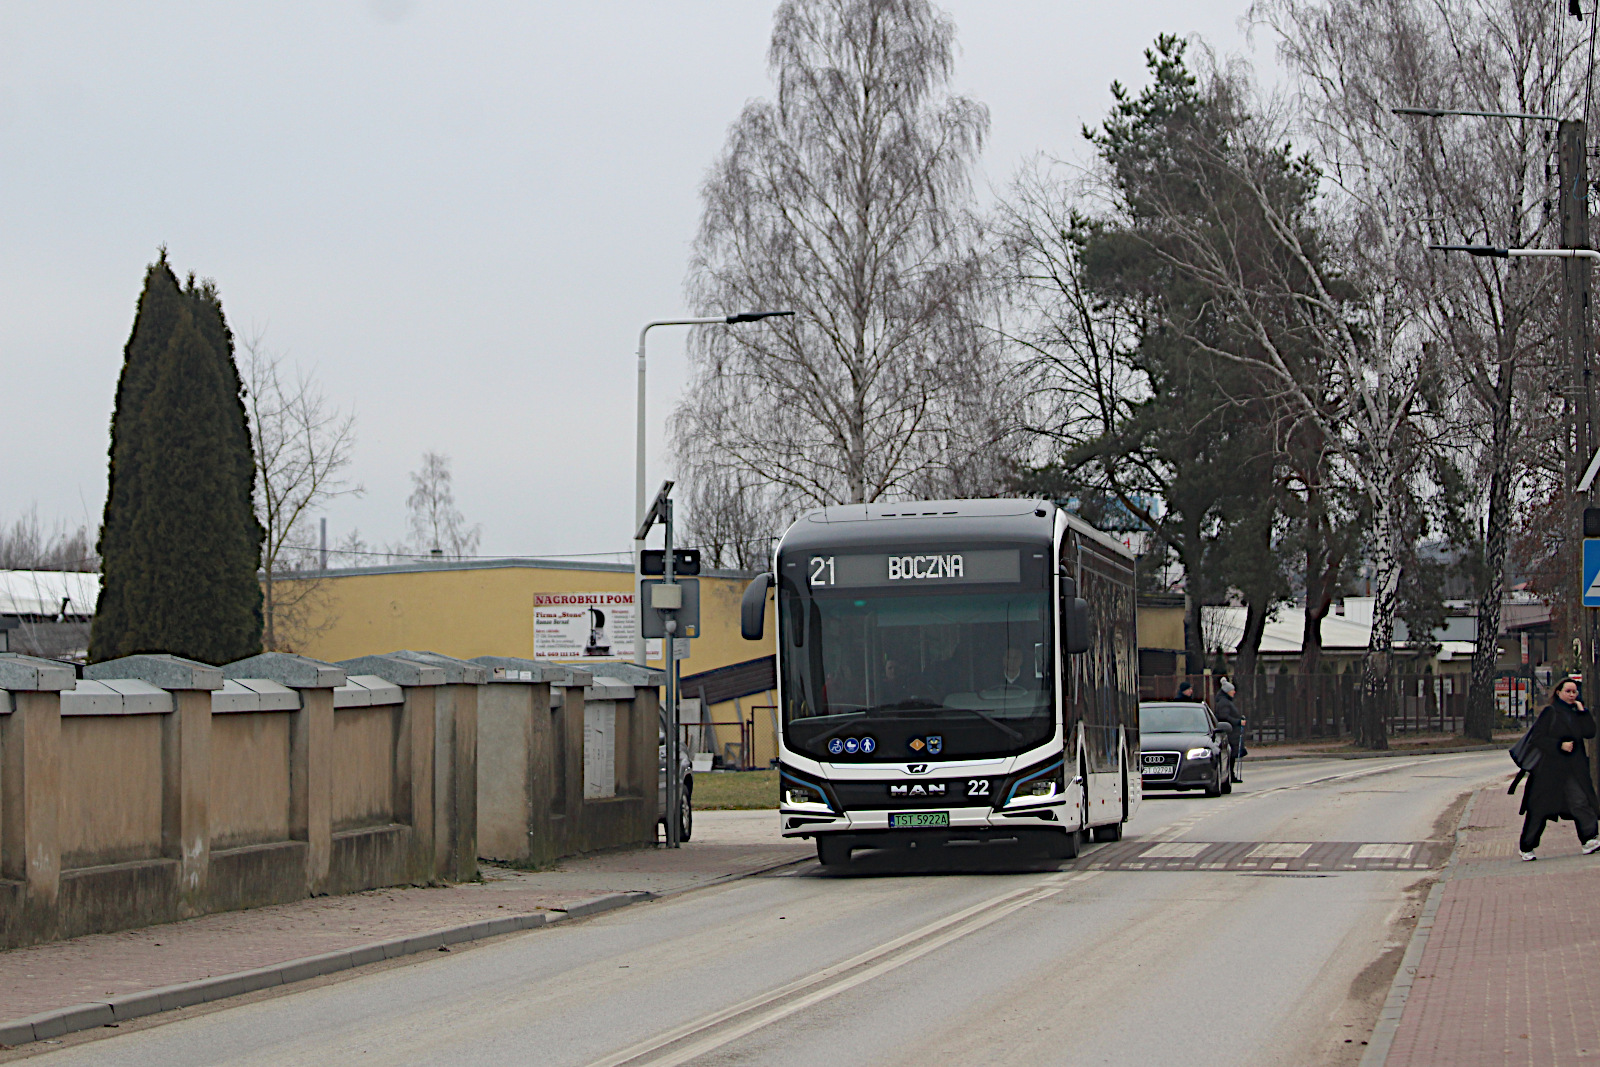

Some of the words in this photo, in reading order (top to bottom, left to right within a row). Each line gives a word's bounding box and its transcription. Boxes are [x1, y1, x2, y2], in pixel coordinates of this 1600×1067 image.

[811, 557, 835, 586] 21
[888, 554, 964, 580] BOCZNA
[536, 595, 597, 604] NAGROBKI
[600, 595, 604, 604] I
[606, 594, 635, 604] POM
[890, 783, 945, 796] MAN
[968, 780, 990, 796] 22
[895, 815, 915, 825] TST
[917, 815, 947, 825] 5922A
